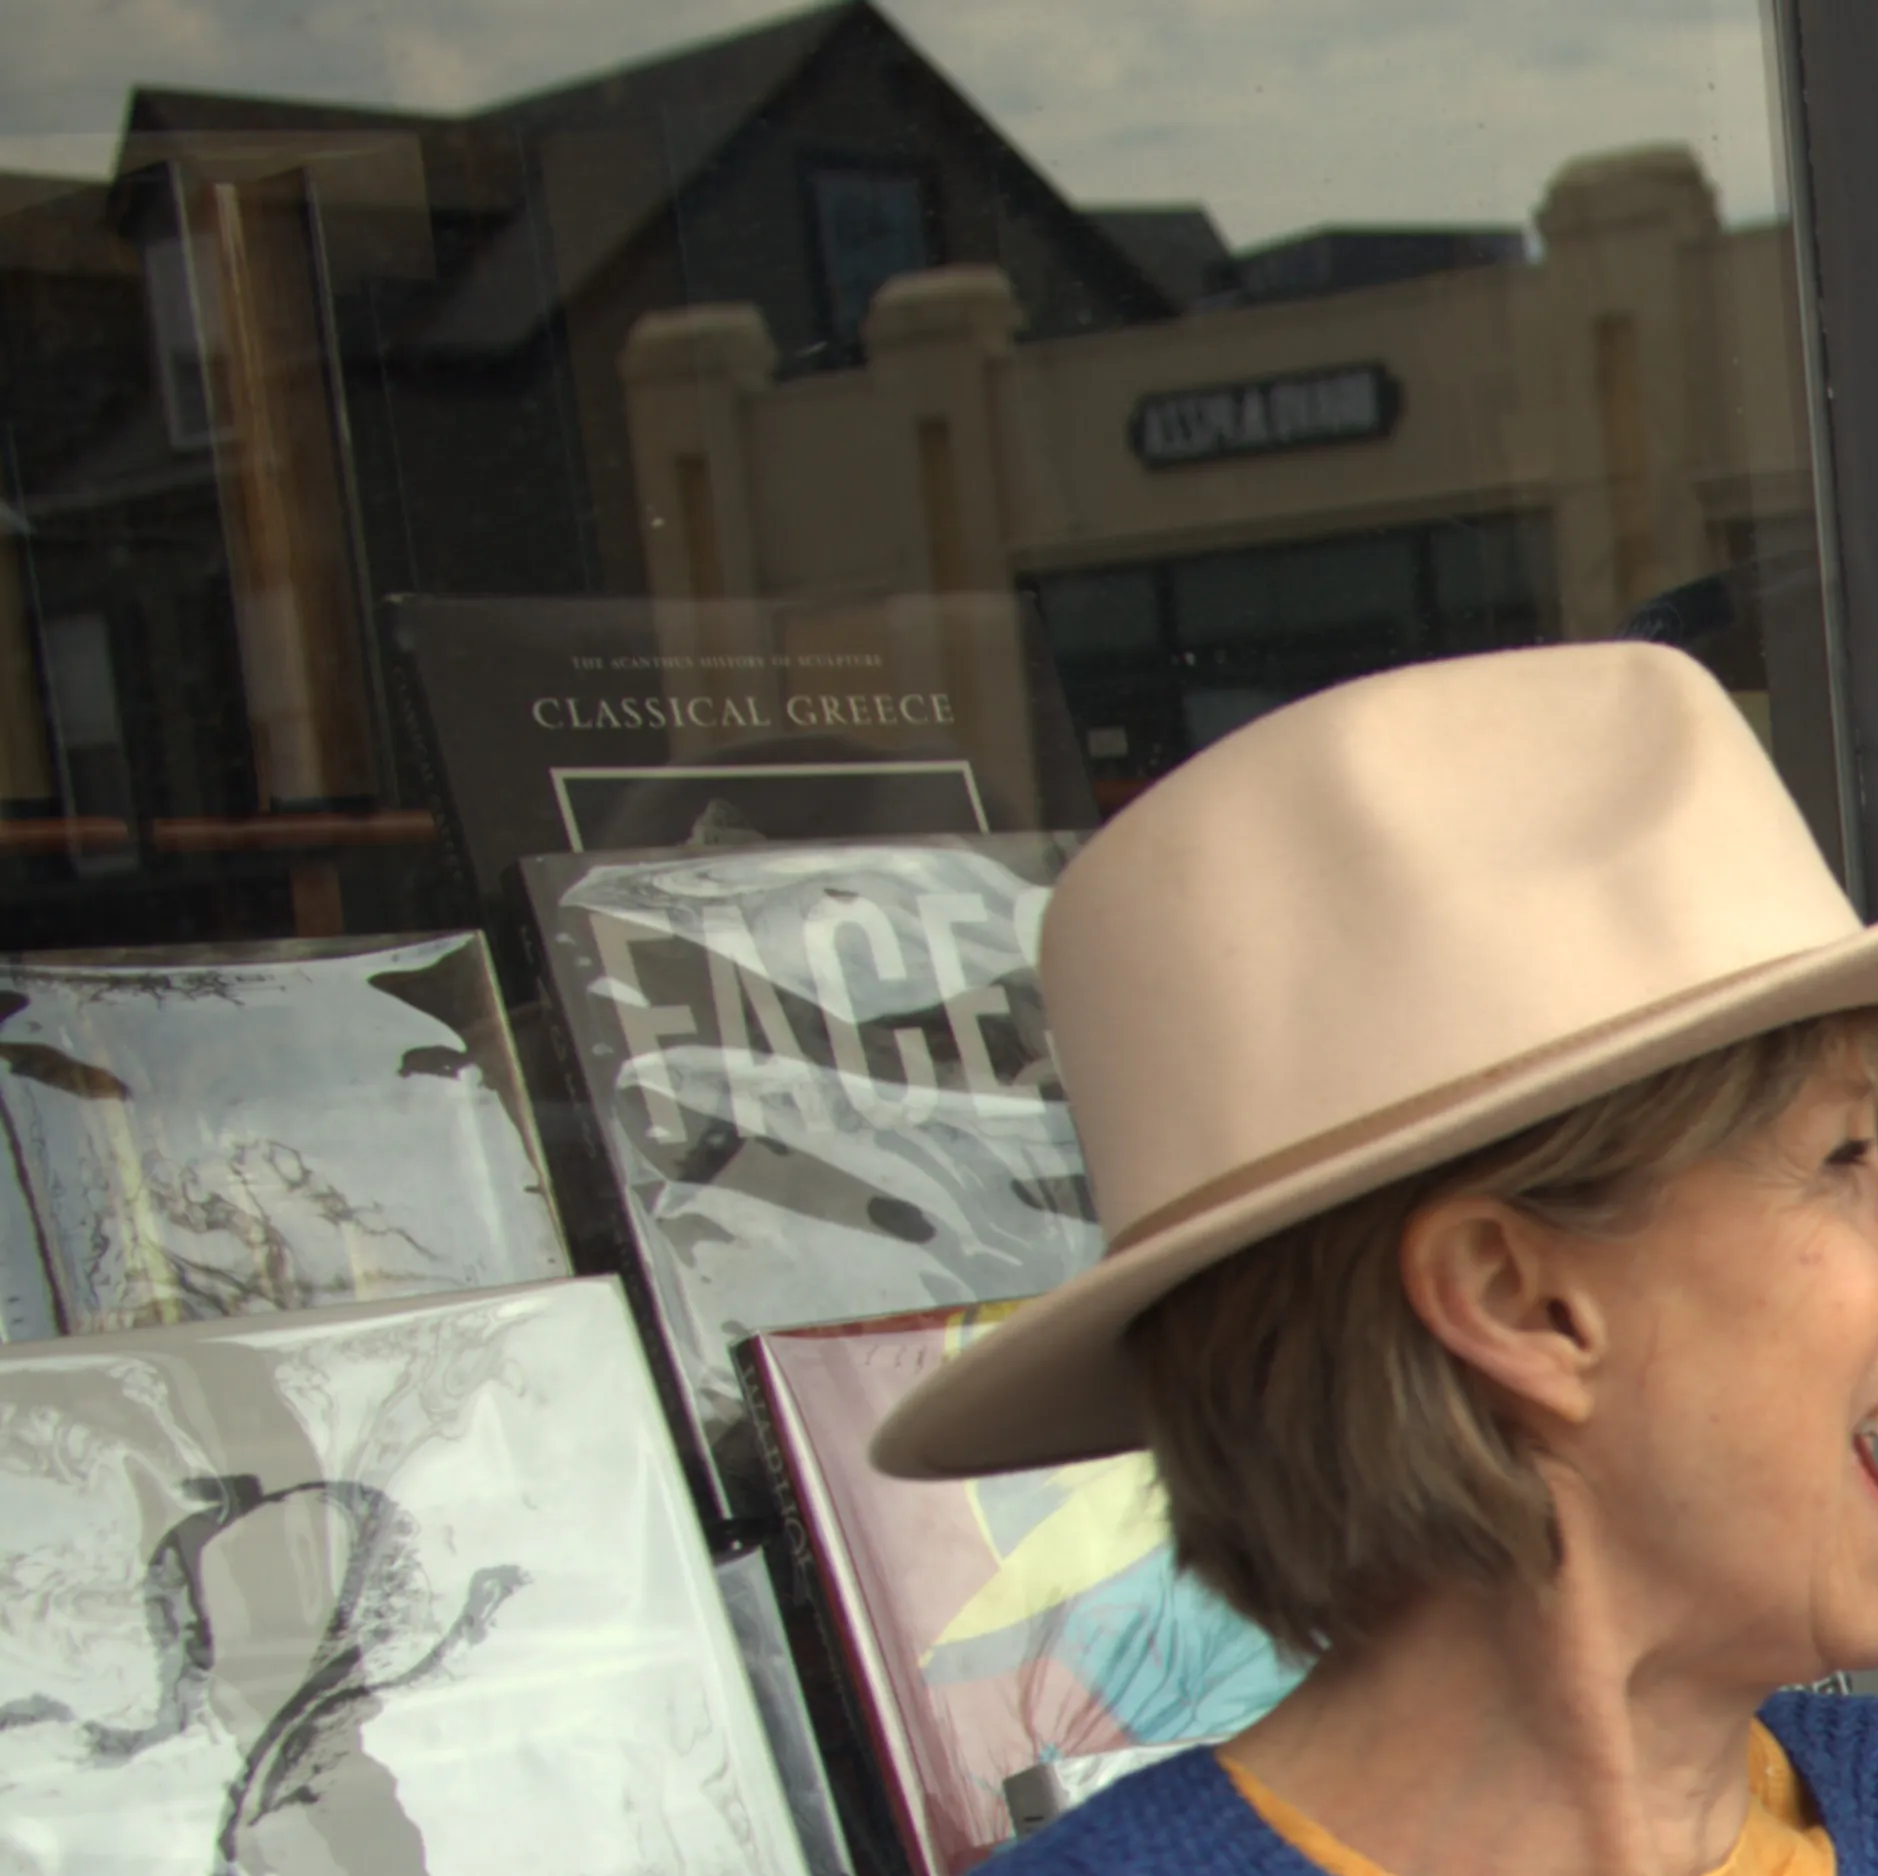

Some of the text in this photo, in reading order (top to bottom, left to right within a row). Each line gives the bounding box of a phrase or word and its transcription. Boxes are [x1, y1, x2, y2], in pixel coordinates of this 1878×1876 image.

[573, 656, 603, 670] THE
[612, 655, 693, 669] ACANTHUS
[701, 655, 766, 669] HISTORY
[797, 653, 882, 668] SCULPTURE
[532, 692, 955, 730] CLASSICAL GREECE
